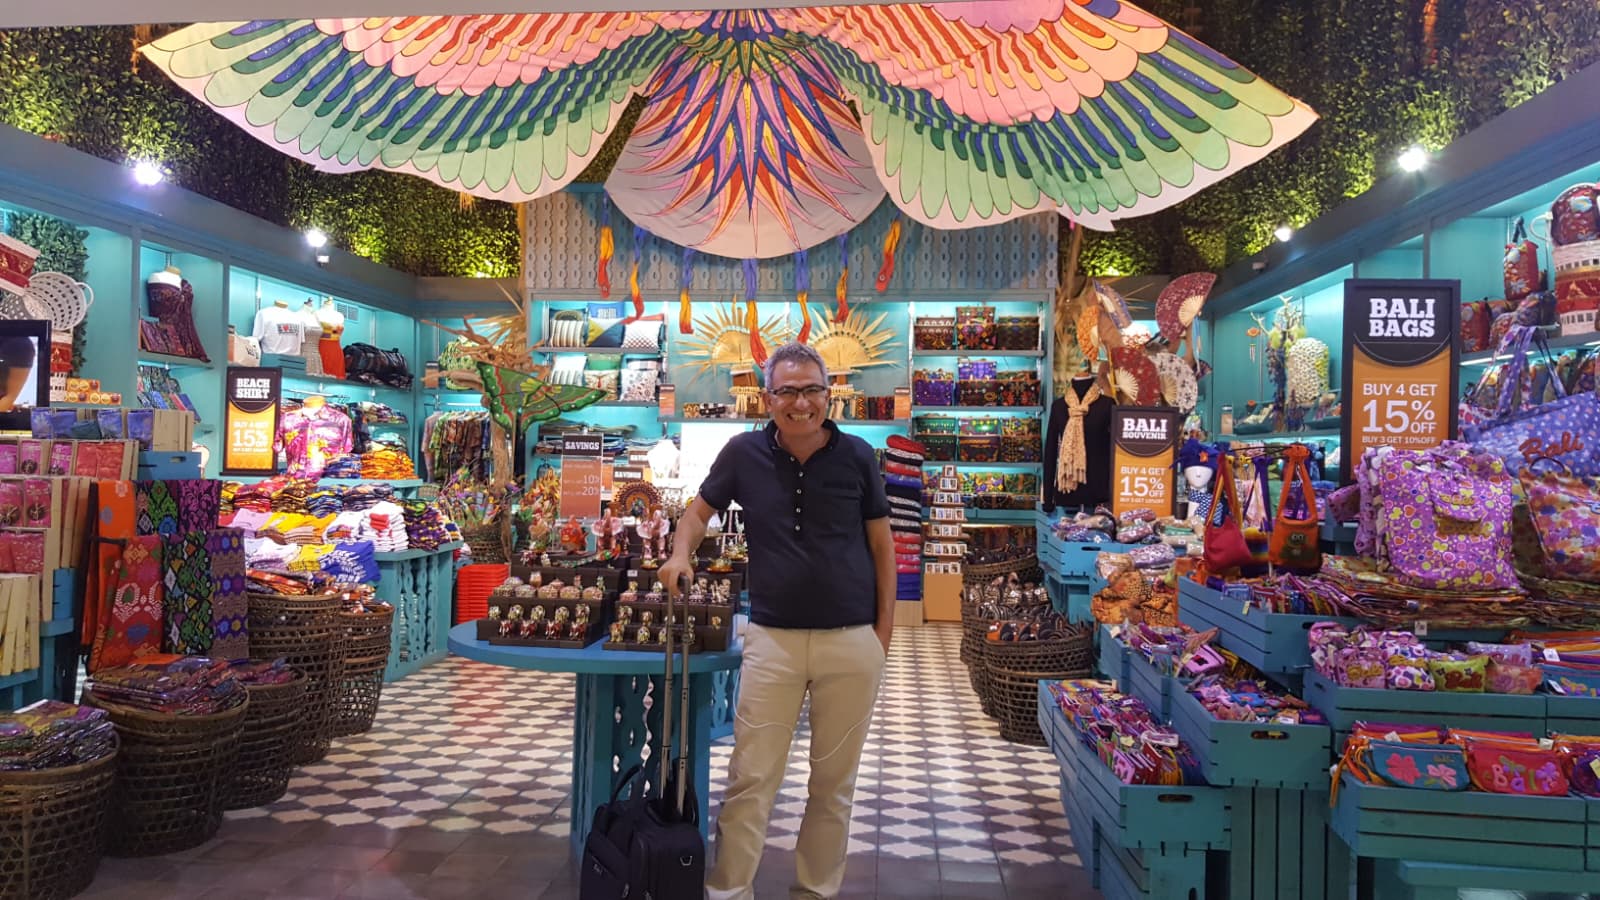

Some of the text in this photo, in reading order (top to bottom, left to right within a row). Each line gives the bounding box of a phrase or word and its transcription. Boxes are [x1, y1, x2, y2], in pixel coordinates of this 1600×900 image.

[1369, 298, 1436, 319] BALI
[1368, 319, 1435, 338] BAGS
[236, 378, 270, 388] BEACH
[235, 388, 270, 399] SHIRT
[1363, 383, 1437, 397] BUY 4 GET
[1123, 418, 1168, 432] BALI
[1410, 421, 1437, 434] OFF
[1122, 431, 1167, 440] SOUVENIR
[1362, 436, 1379, 444] BUY
[1387, 436, 1403, 444] GET
[565, 441, 600, 450] SAVINGS
[1518, 431, 1585, 465] Bali
[1121, 466, 1166, 476] BUY 4 GET
